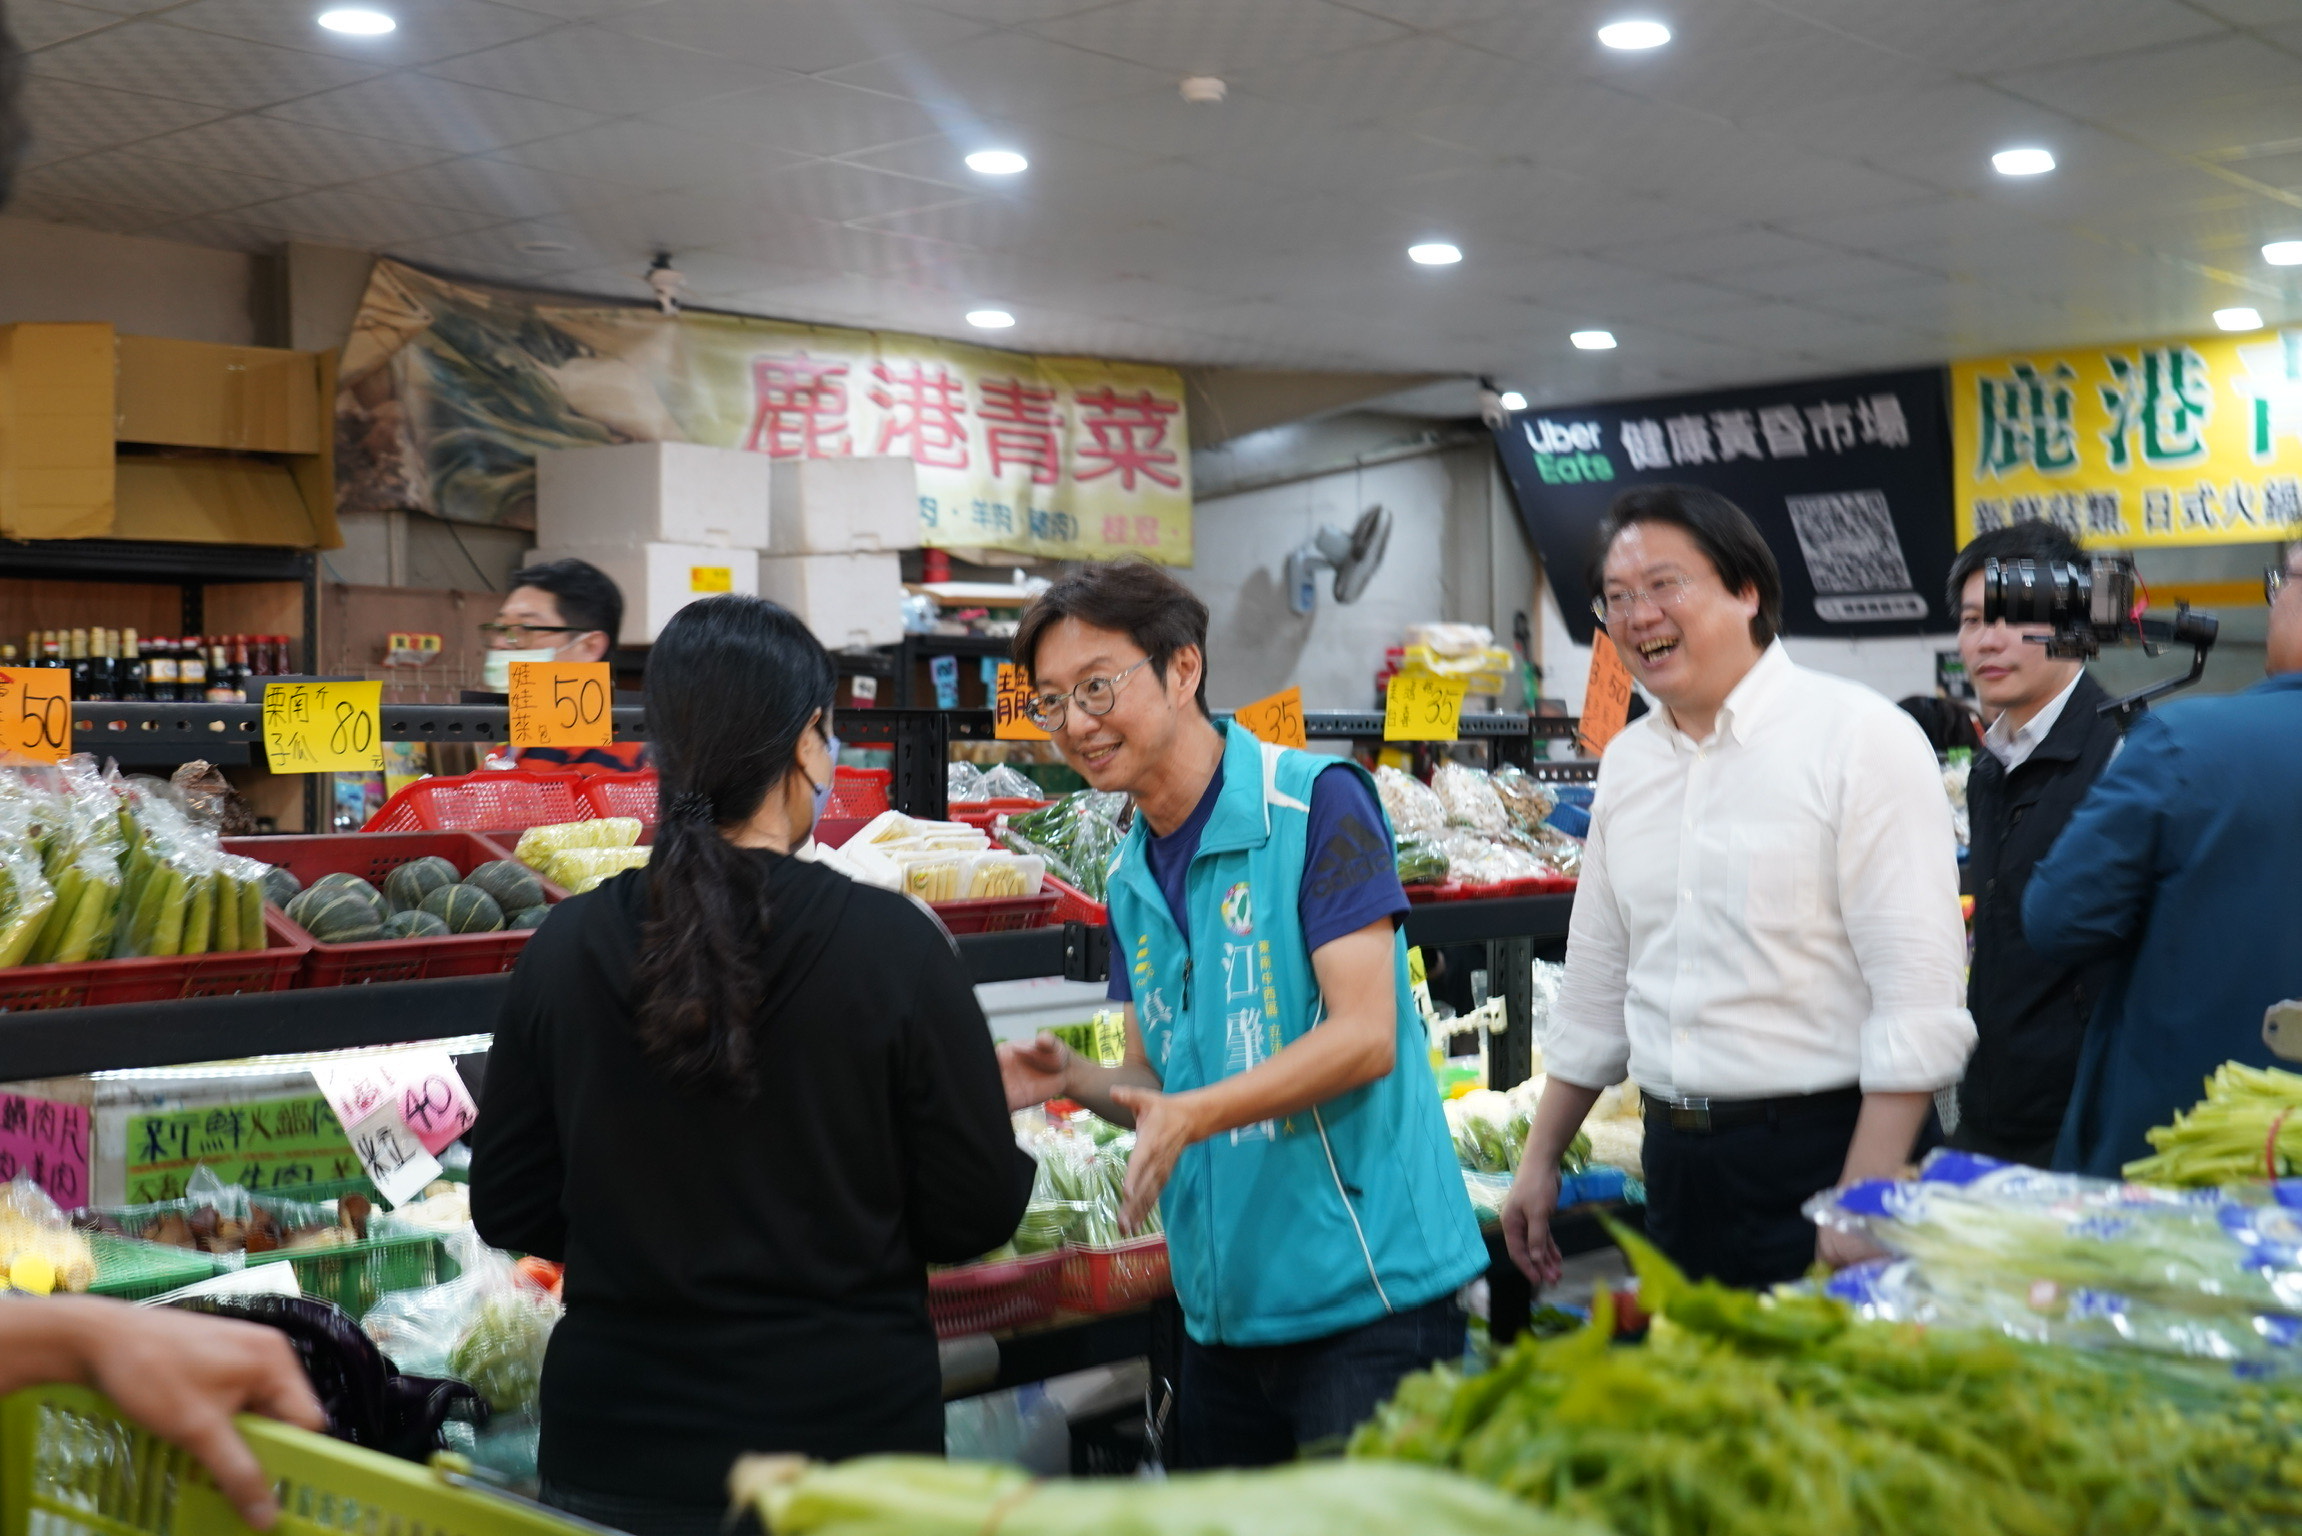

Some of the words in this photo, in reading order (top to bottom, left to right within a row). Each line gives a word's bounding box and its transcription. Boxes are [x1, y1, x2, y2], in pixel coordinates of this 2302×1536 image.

[746, 352, 1181, 490] 鹿港青菜
[1524, 418, 1602, 454] Uber
[1620, 392, 1908, 471] 健康黃昏市場
[1534, 453, 1615, 485] Eats
[22, 683, 68, 748] 50
[330, 701, 372, 755] 80
[554, 675, 604, 729] 50
[1264, 699, 1298, 744] 35
[1424, 689, 1460, 726] 35
[406, 1075, 452, 1132] 40
